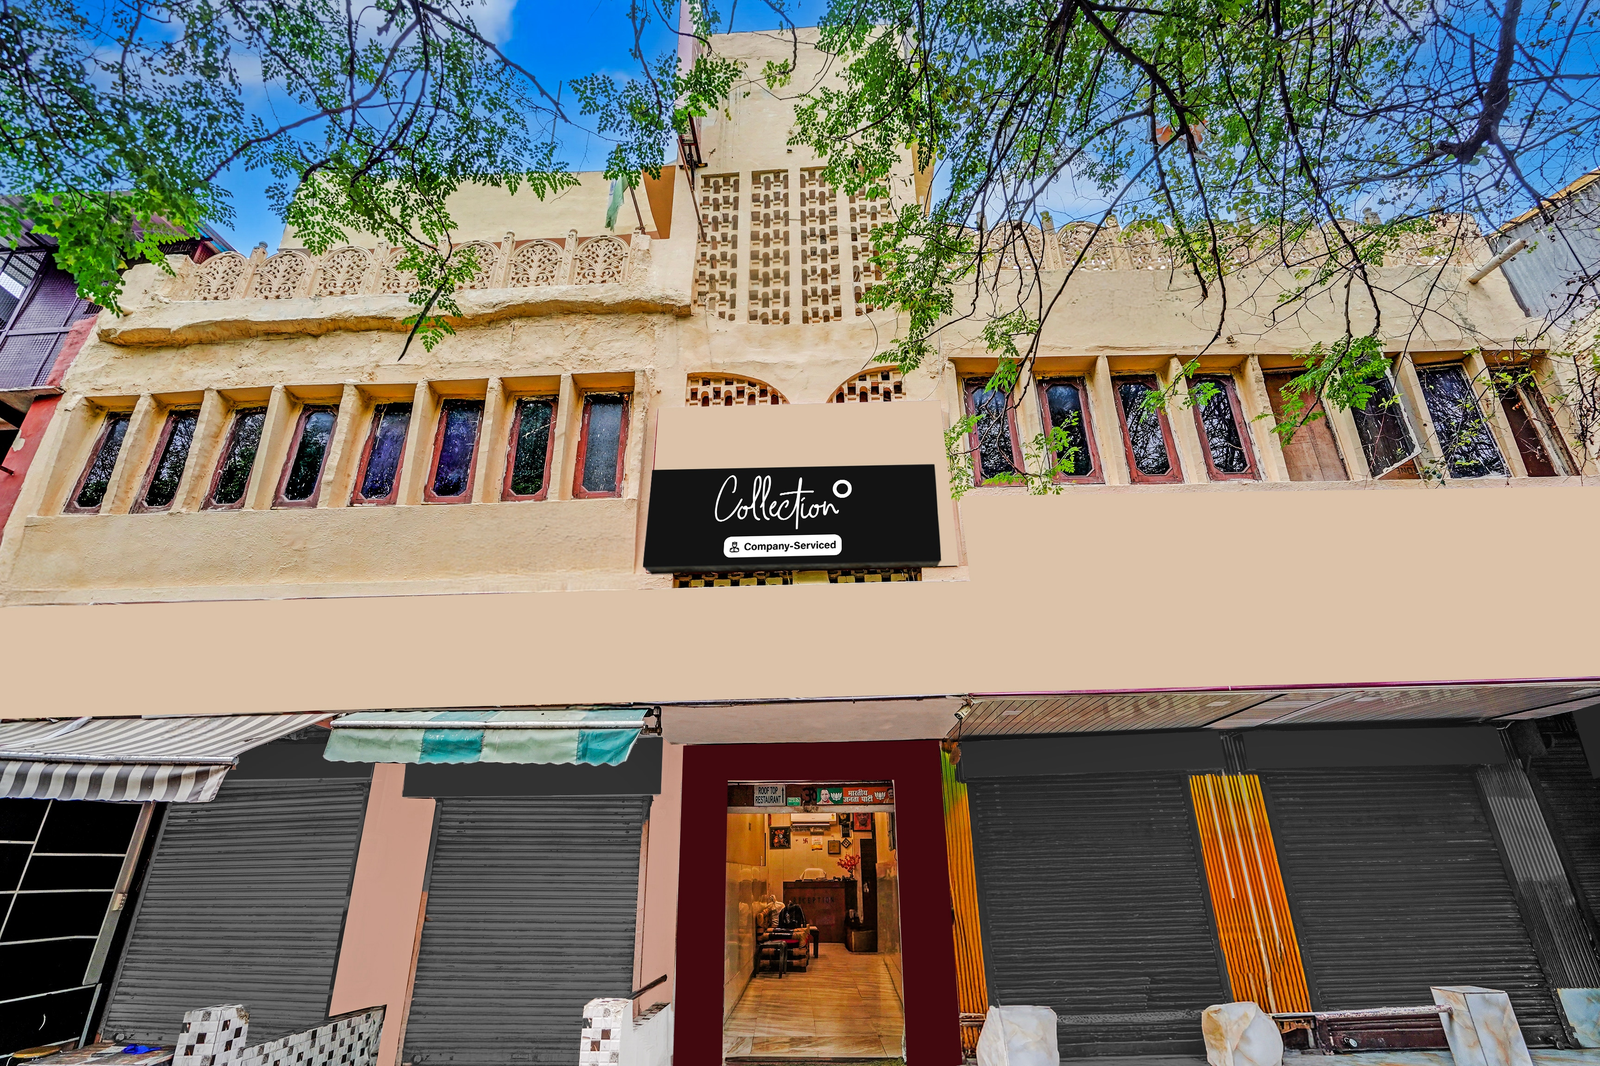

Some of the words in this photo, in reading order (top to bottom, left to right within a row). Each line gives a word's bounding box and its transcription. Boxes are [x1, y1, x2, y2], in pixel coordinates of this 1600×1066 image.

[714, 474, 839, 530] Collection
[743, 540, 837, 553] Company-Serviced
[758, 786, 769, 794] ROOF
[770, 786, 778, 794] TOP
[755, 795, 781, 804] RESTAURANT
